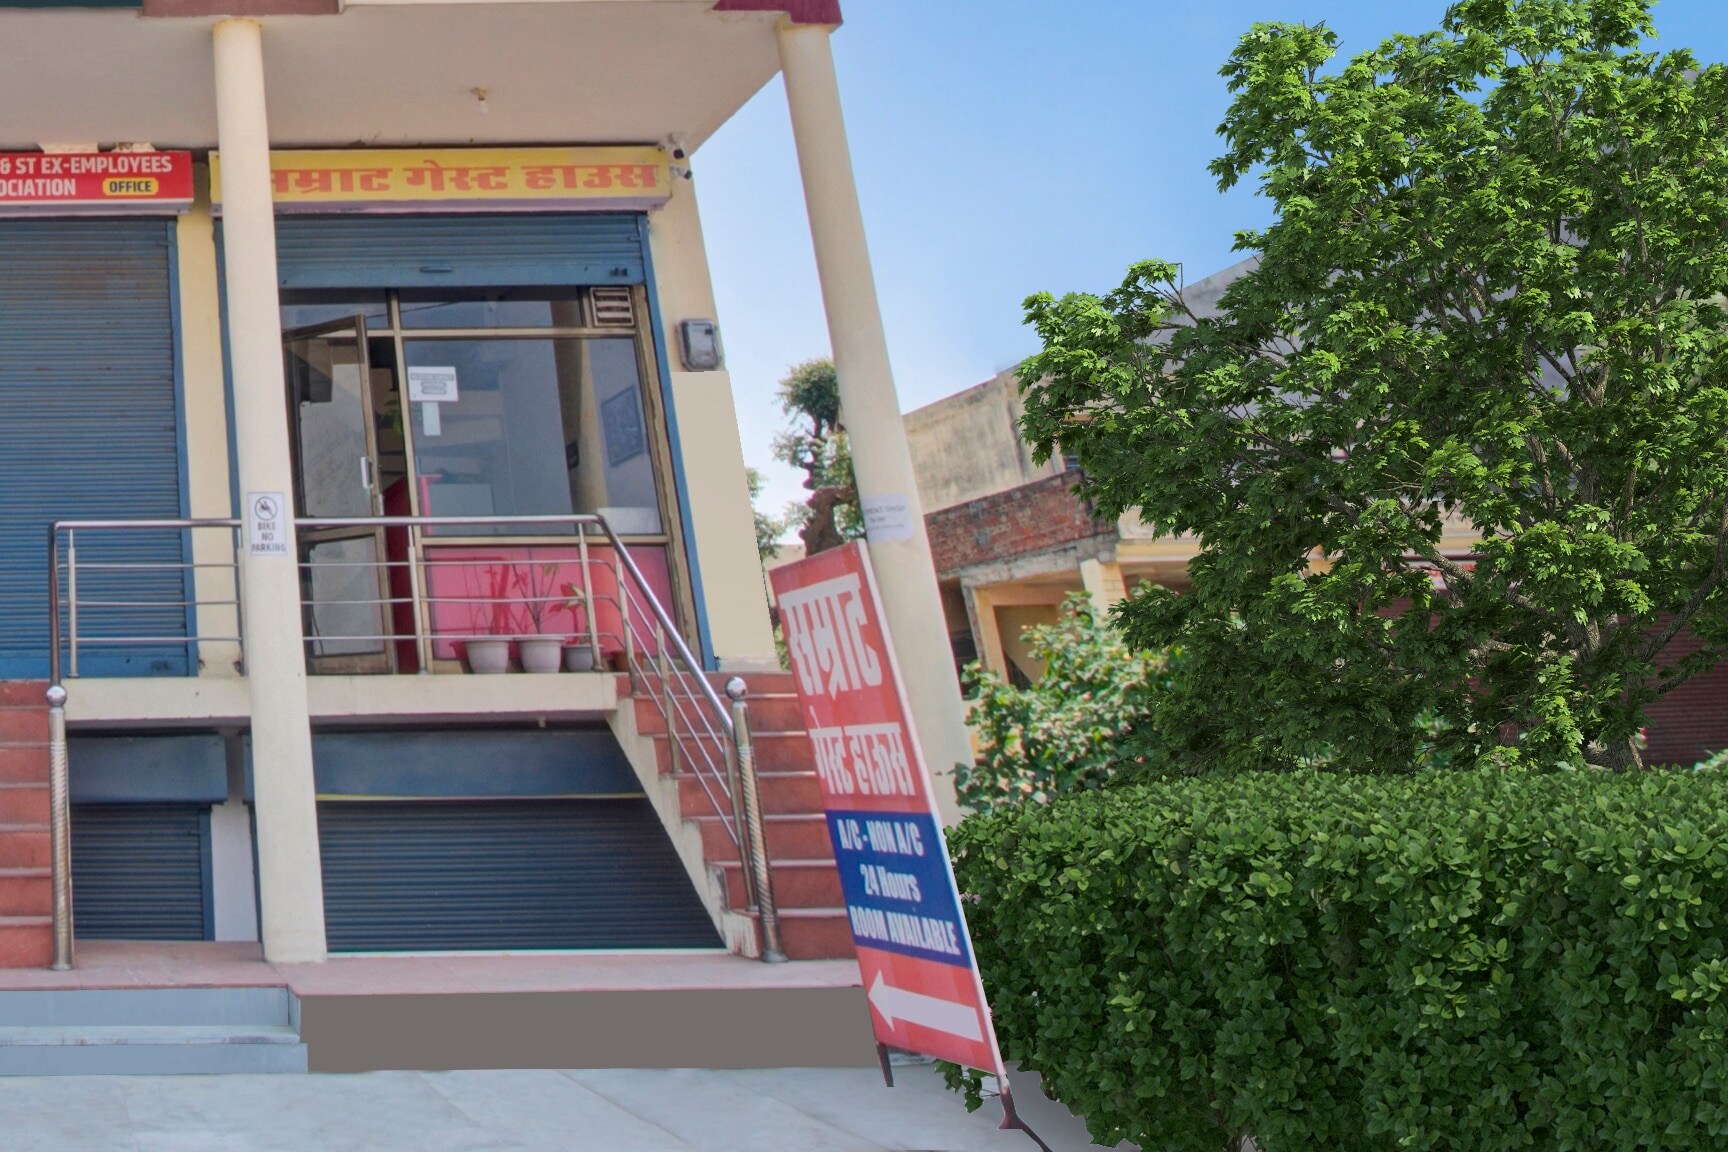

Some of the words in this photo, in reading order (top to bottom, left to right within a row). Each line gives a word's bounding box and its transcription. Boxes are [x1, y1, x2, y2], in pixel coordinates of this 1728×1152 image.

[0, 157, 11, 174] &
[15, 157, 37, 174] ST
[41, 156, 172, 174] EX-EMPLOYEES
[403, 159, 511, 191] गेस्ट
[109, 180, 152, 193] OFFICE
[257, 522, 276, 531] BIKE
[262, 532, 274, 541] NO
[252, 543, 287, 552] PARKING
[778, 572, 882, 700] सम्राट
[809, 705, 854, 795] गेस्ट
[837, 819, 863, 851] A/C
[866, 820, 897, 853] NON
[894, 822, 924, 856] A/C
[860, 863, 880, 896] 24
[876, 865, 921, 902] Hours
[849, 905, 889, 941] ROOM
[886, 911, 961, 955] AVAILABLE
